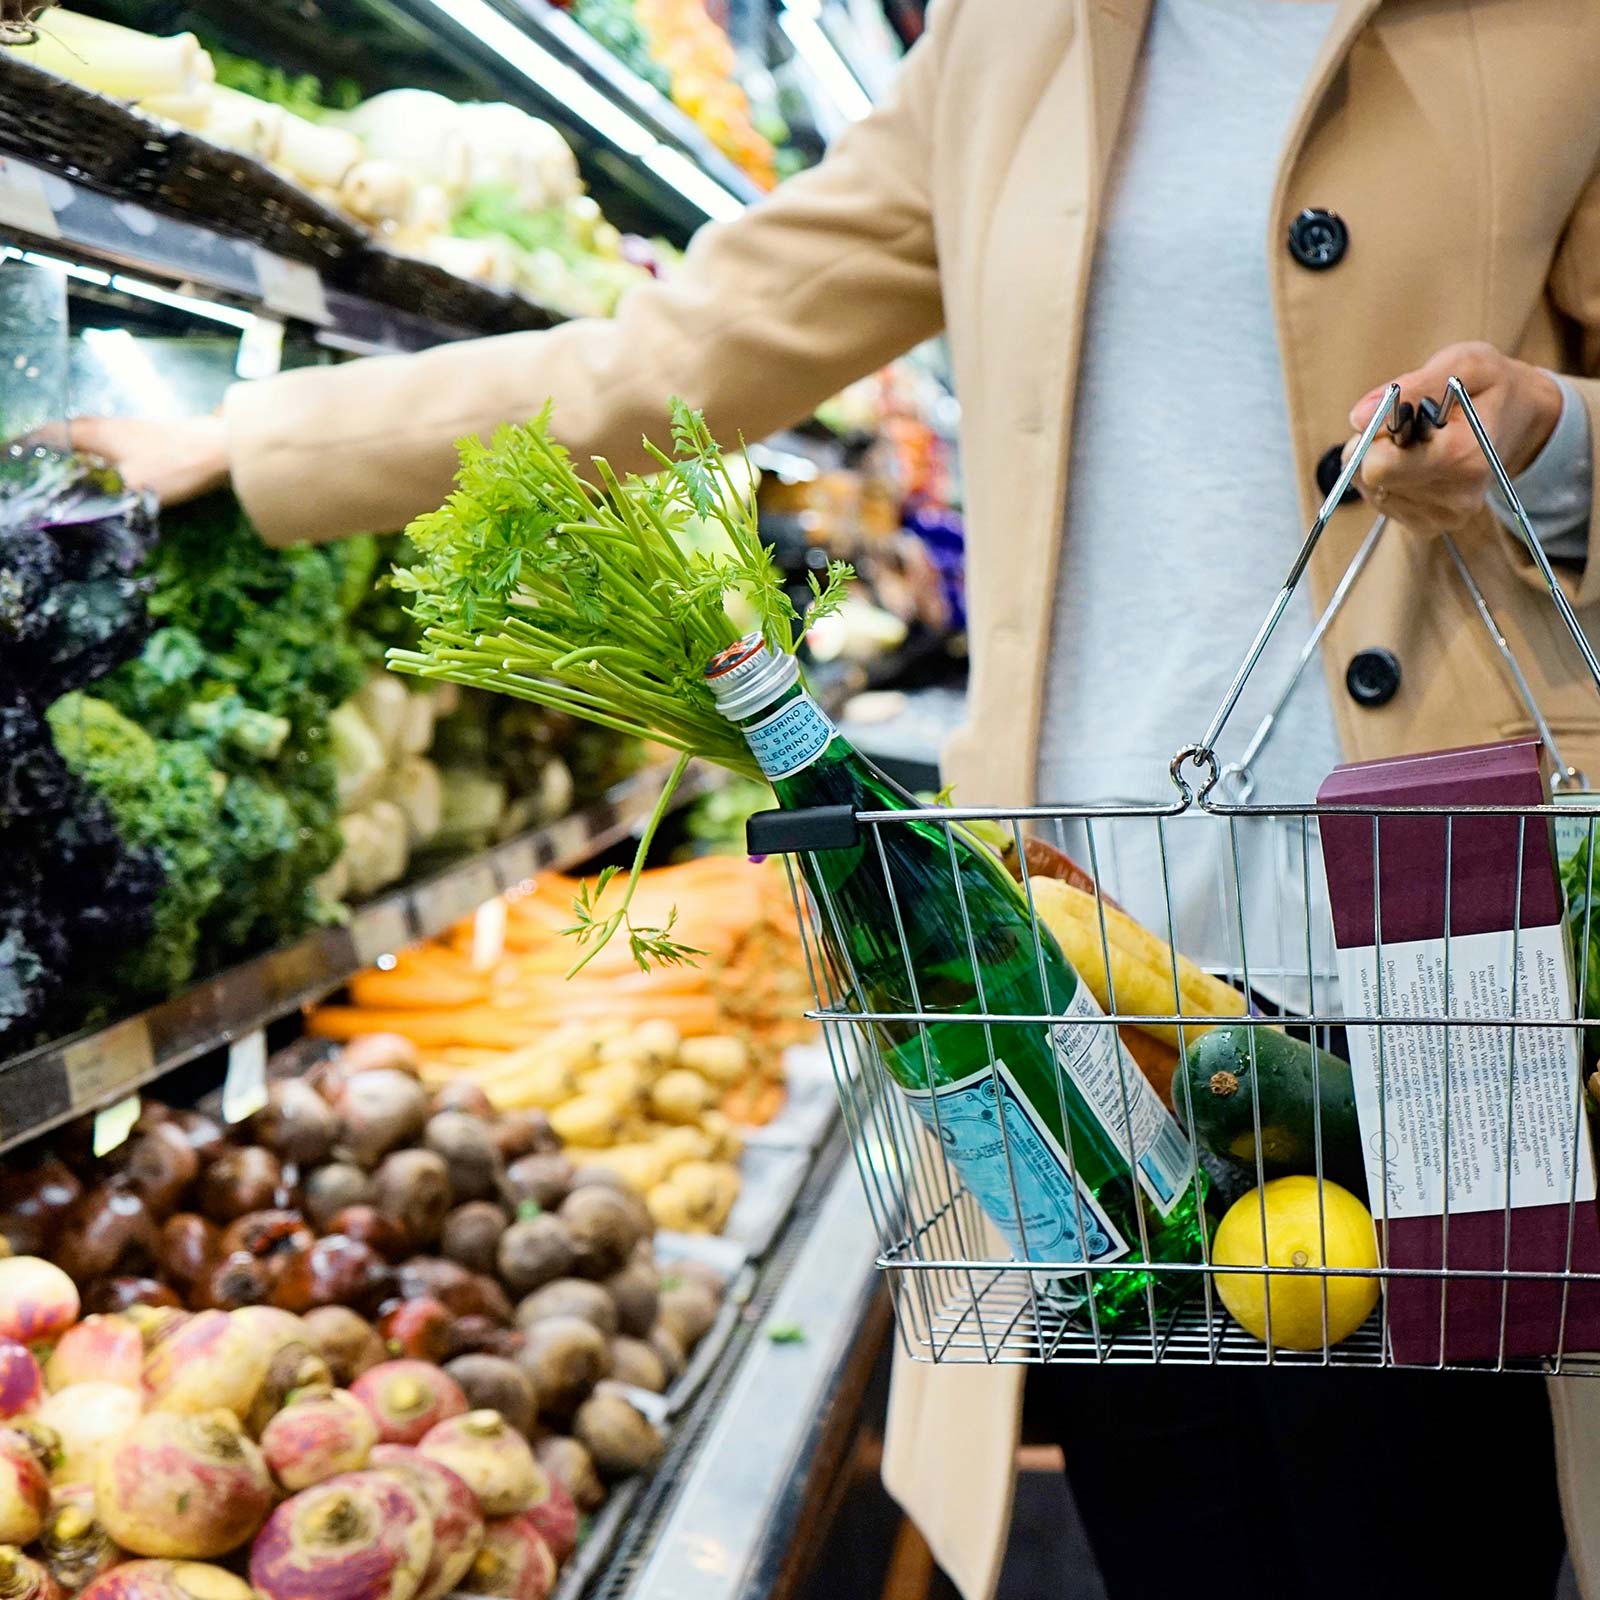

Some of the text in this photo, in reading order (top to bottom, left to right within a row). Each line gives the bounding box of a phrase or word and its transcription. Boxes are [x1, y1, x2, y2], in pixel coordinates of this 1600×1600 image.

[1415, 953, 1426, 972] Seul
[1435, 957, 1443, 967] de
[1535, 949, 1547, 985] delicious
[1546, 956, 1554, 966] At
[1360, 968, 1368, 987] vous
[1386, 959, 1399, 996] Délicieux
[1418, 973, 1426, 984] un
[1477, 970, 1486, 983] but
[1486, 964, 1496, 987] these
[1546, 967, 1558, 994] Lesley
[1363, 989, 1370, 999] ne
[1479, 985, 1489, 1007] really
[1521, 982, 1529, 996] her
[1392, 998, 1398, 1008] au
[1419, 985, 1431, 1014] produit
[1489, 989, 1499, 1016] unique
[1531, 993, 1539, 1006] are
[1367, 1033, 1377, 1050] plus
[1387, 1032, 1395, 1043] de
[1415, 1024, 1427, 1055] pouvait
[1486, 1032, 1495, 1053] when
[1518, 1032, 1528, 1061] scratch
[1536, 1033, 1545, 1050] with
[1397, 1042, 1405, 1056] ces
[1406, 1038, 1418, 1065] POUR
[1456, 1043, 1466, 1068] Foods
[1546, 1035, 1558, 1069] fabulous
[1557, 1044, 1568, 1068] Foods
[1426, 965, 1434, 984] avec
[1451, 1148, 1459, 1159] de
[1427, 1045, 1439, 1078] fabriqué
[1488, 1055, 1499, 1083] topped
[1498, 1054, 1506, 1066] are
[1529, 1057, 1539, 1074] only
[1539, 1051, 1547, 1069] care
[1398, 1058, 1412, 1099] craquelins
[1410, 1066, 1420, 1086] CES
[1419, 1056, 1431, 1091] satisfaire
[1448, 1060, 1460, 1093] fabuleux
[1459, 1070, 1469, 1093] adore
[1468, 970, 1501, 1173] cheese or We are addicted to this yummy
[1472, 1069, 1480, 1086] sure
[1521, 1063, 1531, 1084] using
[1542, 1071, 1549, 1079] in
[1560, 1070, 1568, 1082] we
[1394, 1086, 1402, 1097] de
[1432, 1080, 1441, 1099] avec
[1493, 1084, 1501, 1101] with
[1532, 1076, 1540, 1091] way
[1542, 1080, 1552, 1102] small
[1550, 1070, 1561, 1095] crisps
[1562, 1084, 1571, 1101] love
[1412, 1086, 1423, 1107] FINS
[1473, 1087, 1482, 1103] you
[1535, 1093, 1542, 1101] to
[1395, 1099, 1407, 1132] fromage
[1405, 1101, 1414, 1117] sont
[1423, 1093, 1434, 1119] Lesley
[1435, 1100, 1444, 1115] des
[1452, 1095, 1465, 1136] craquelins
[1461, 1095, 1474, 1130] fabriquer
[1477, 1104, 1485, 1117] will
[1494, 1102, 1503, 1120] your
[1526, 1101, 1536, 1123] finest
[1536, 1103, 1545, 1125] make
[1554, 1096, 1563, 1115] from
[1429, 1120, 1436, 1128] et
[1479, 1119, 1487, 1129] be
[1564, 1103, 1575, 1132] making
[1400, 1133, 1407, 1143] ou
[1408, 1118, 1421, 1164] irrésistibles
[1415, 1109, 1431, 1167] CRAQUELINS
[1467, 1132, 1475, 1140] et
[1556, 1117, 1568, 1148] Lesley's
[1459, 1137, 1467, 1155] sont
[1468, 1142, 1477, 1160] vous
[1539, 1134, 1549, 1155] great
[1460, 1156, 1474, 1194] fabriqués
[1471, 1162, 1481, 1180] offrir
[1512, 1158, 1520, 1175] own
[1543, 1157, 1553, 1187] product
[1561, 1151, 1571, 1179] kitchen
